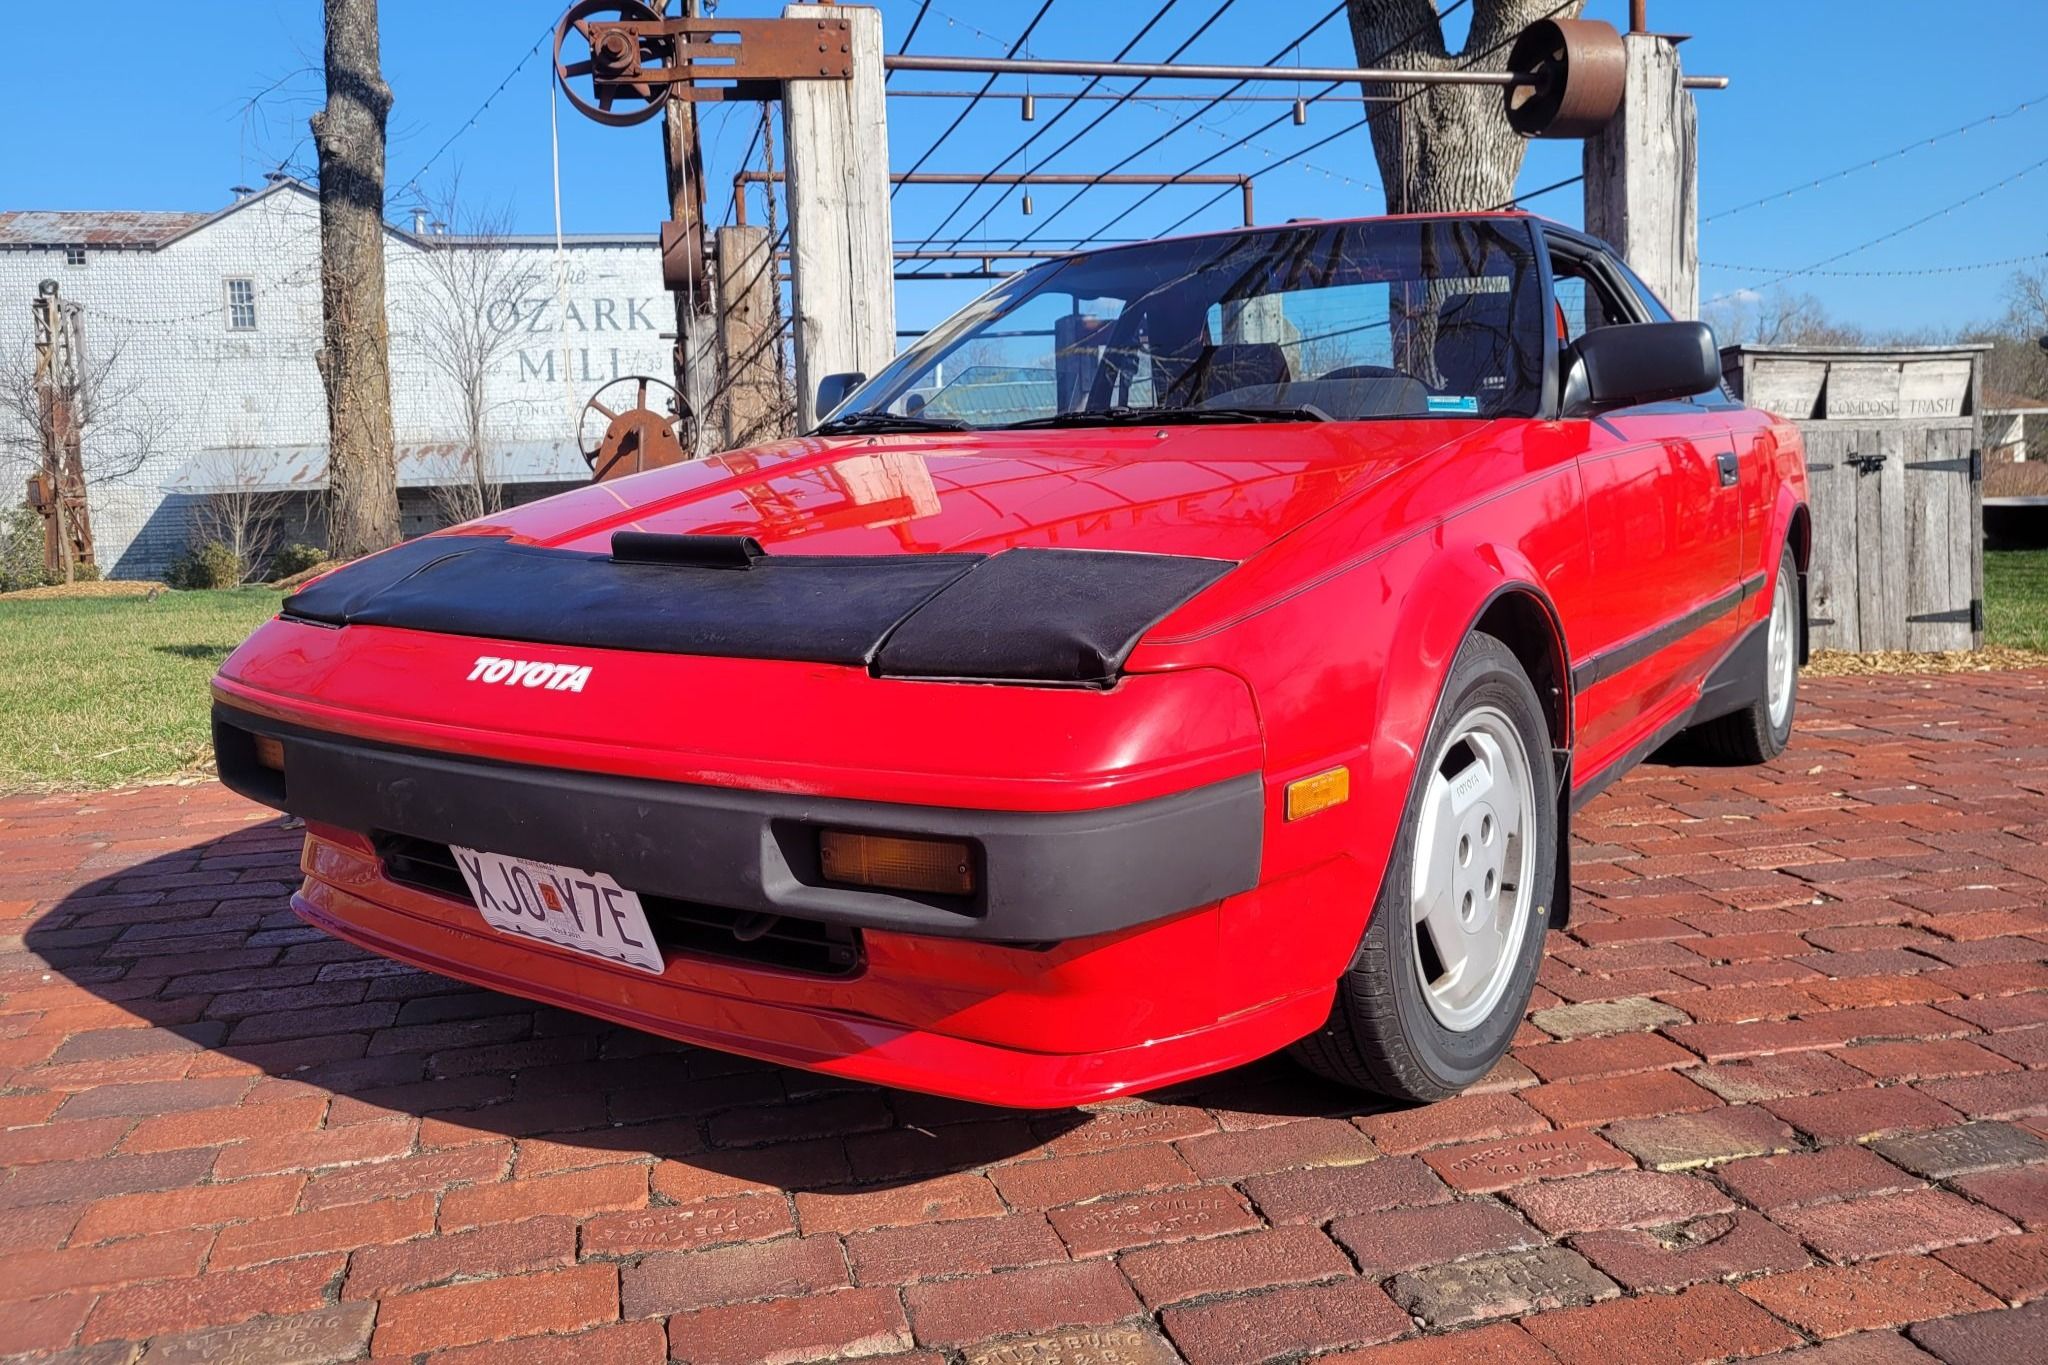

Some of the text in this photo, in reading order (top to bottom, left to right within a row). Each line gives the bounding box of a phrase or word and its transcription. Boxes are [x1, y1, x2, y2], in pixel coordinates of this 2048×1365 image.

[550, 259, 587, 289] The
[486, 297, 656, 333] OZARK
[1829, 399, 1897, 415] COMPOST
[1910, 398, 1955, 414] TRASH
[466, 656, 593, 692] TOYOTA
[1456, 773, 1480, 797] TOYOTA
[550, 874, 644, 948] Y7E
